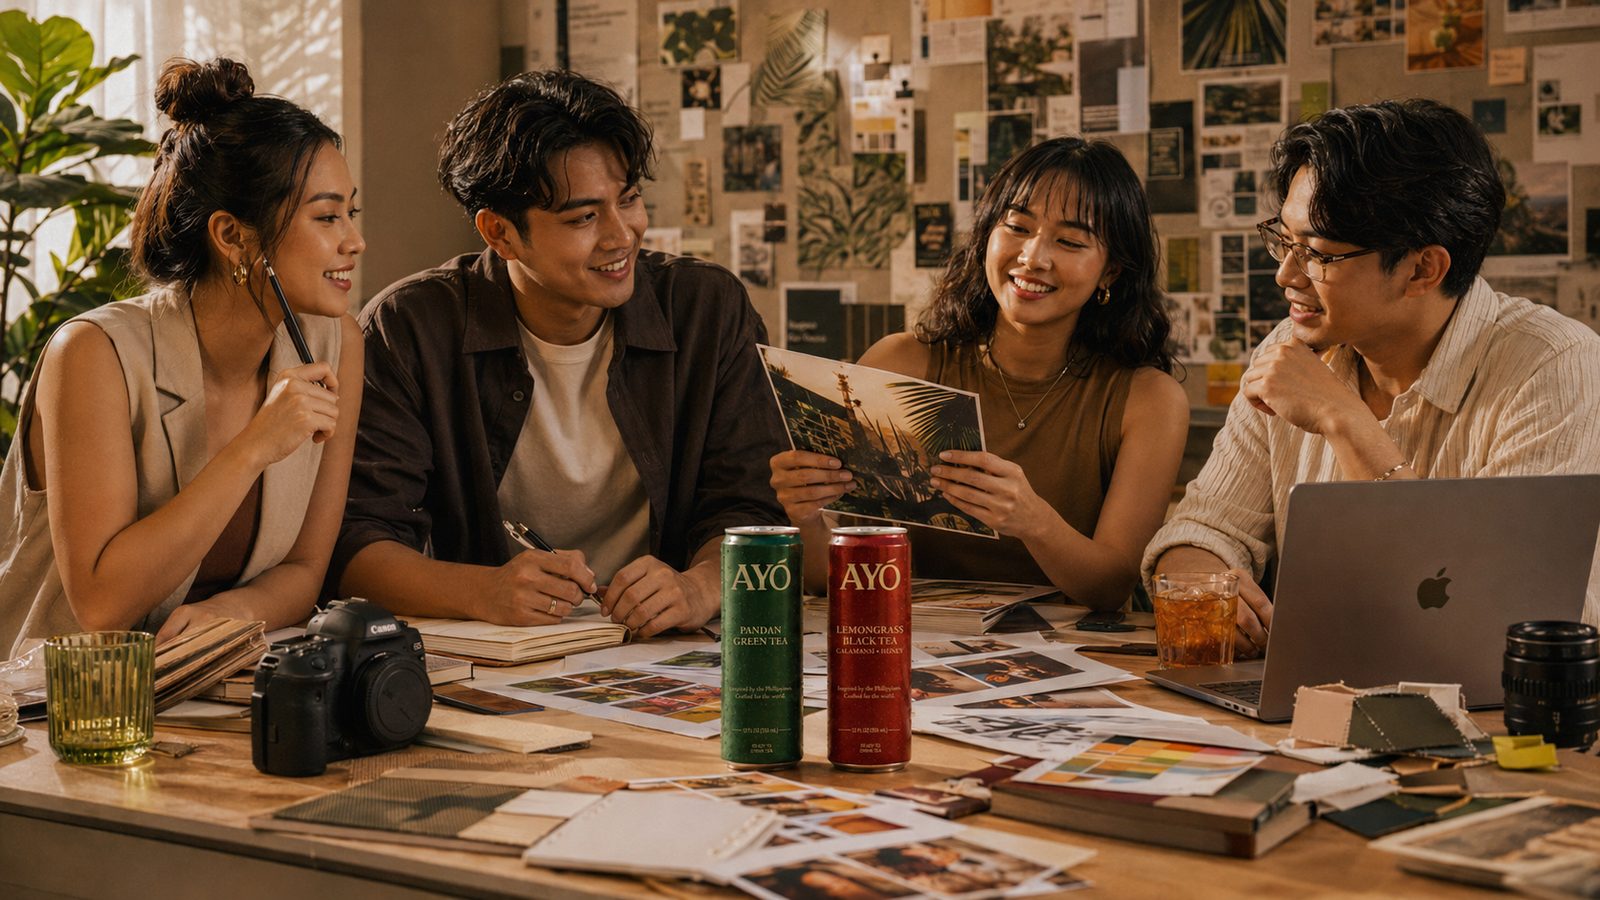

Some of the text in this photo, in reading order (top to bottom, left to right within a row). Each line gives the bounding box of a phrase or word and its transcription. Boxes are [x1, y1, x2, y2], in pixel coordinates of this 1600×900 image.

[731, 558, 792, 591] AYÓ
[839, 558, 901, 591] AYÓ
[370, 623, 397, 634] Canon
[740, 625, 782, 635] PANDAN
[836, 625, 904, 634] LEMONGRASS
[733, 637, 788, 646] GREEN TEA
[843, 636, 898, 646] BLACK TEA
